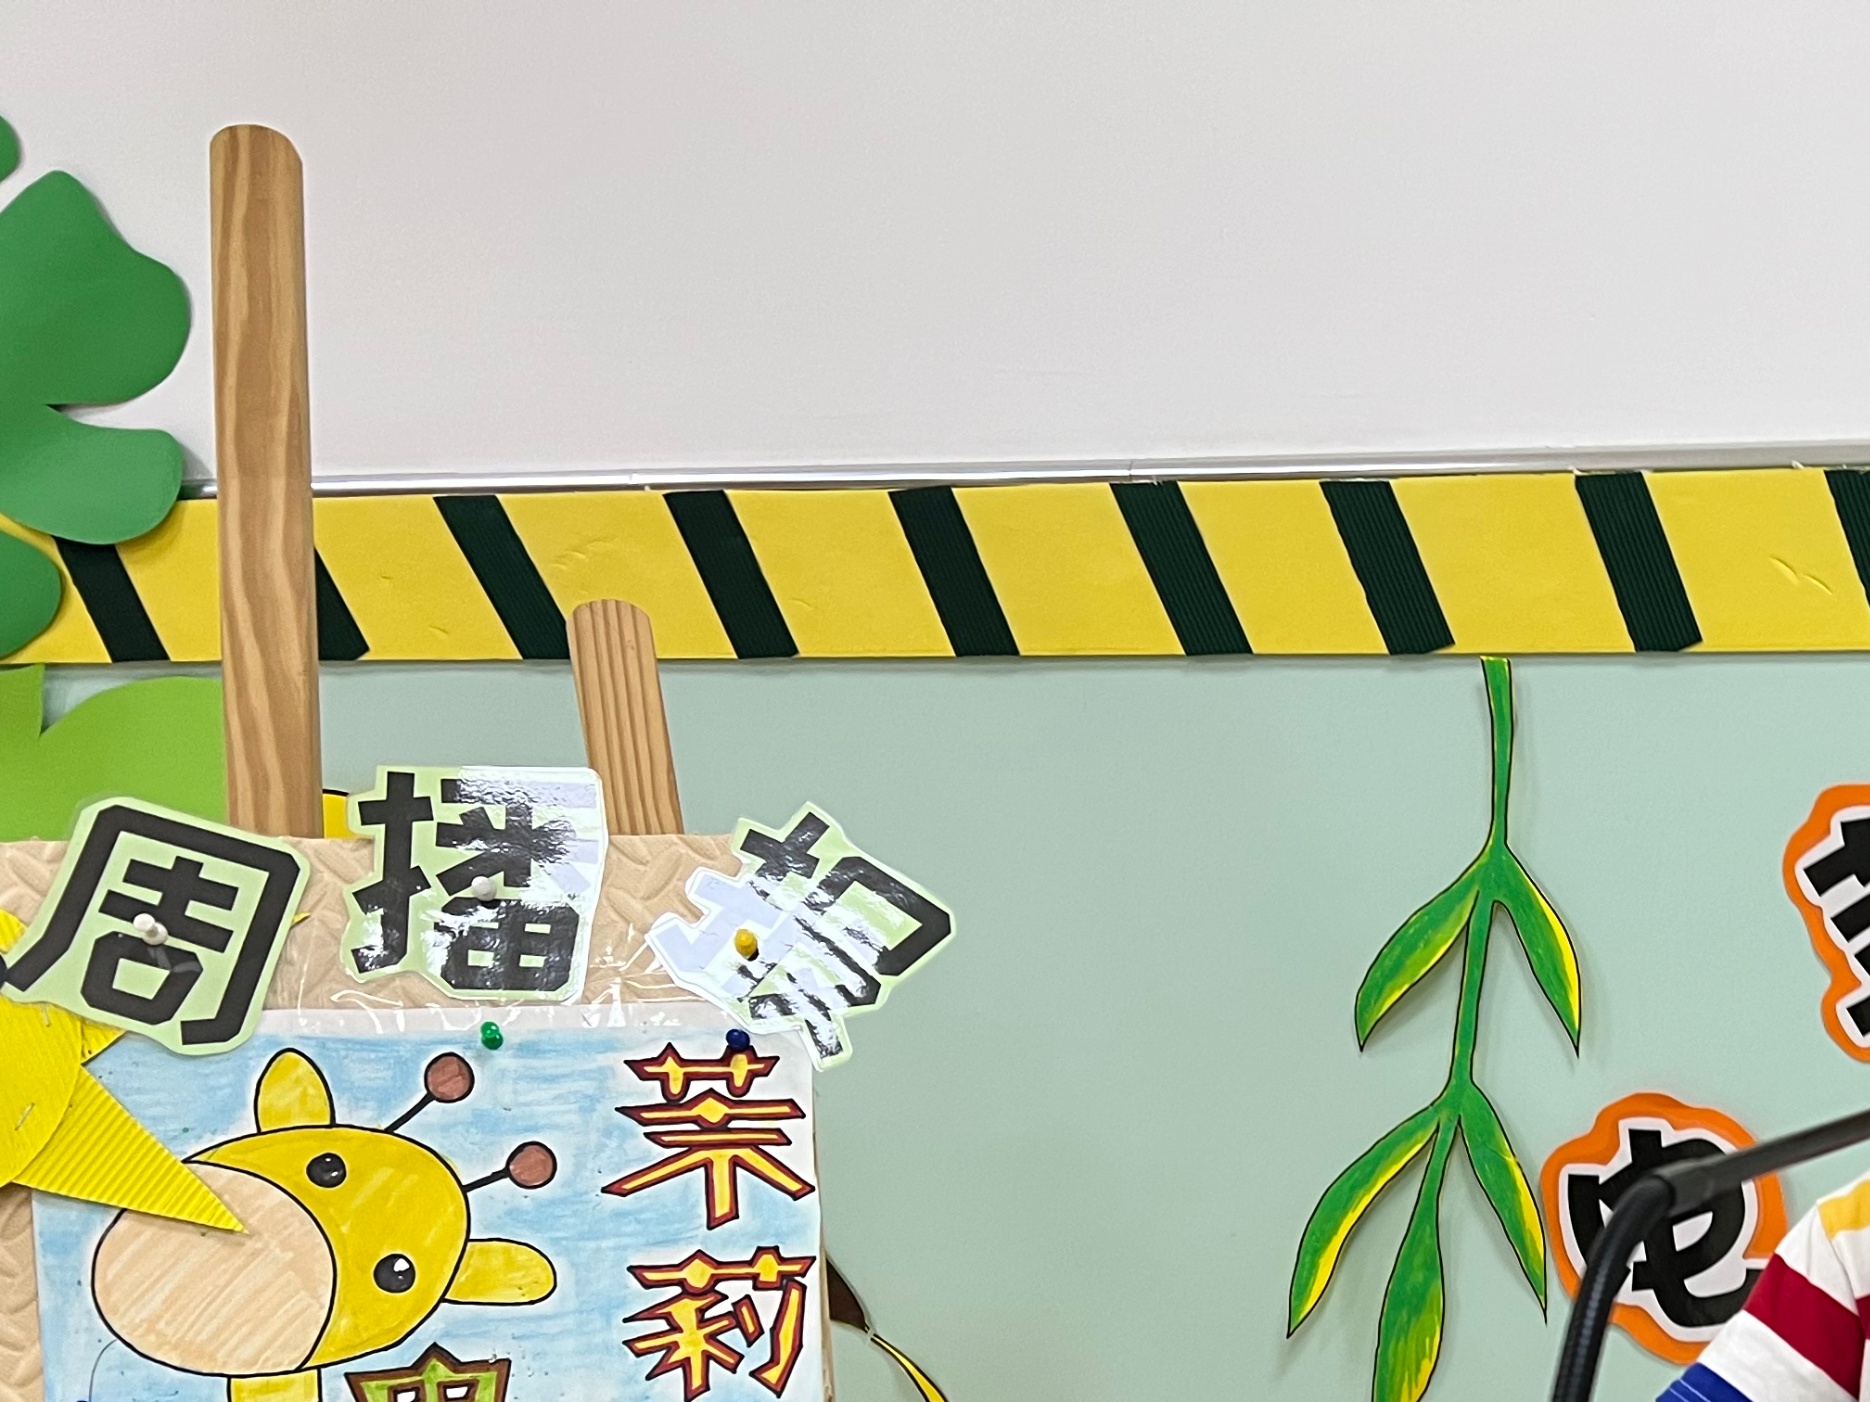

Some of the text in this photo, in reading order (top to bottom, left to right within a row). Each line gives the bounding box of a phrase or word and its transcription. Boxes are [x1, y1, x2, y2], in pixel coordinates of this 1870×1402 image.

[5, 770, 953, 1064] 周播报
[602, 1042, 815, 1402] 茉莉
